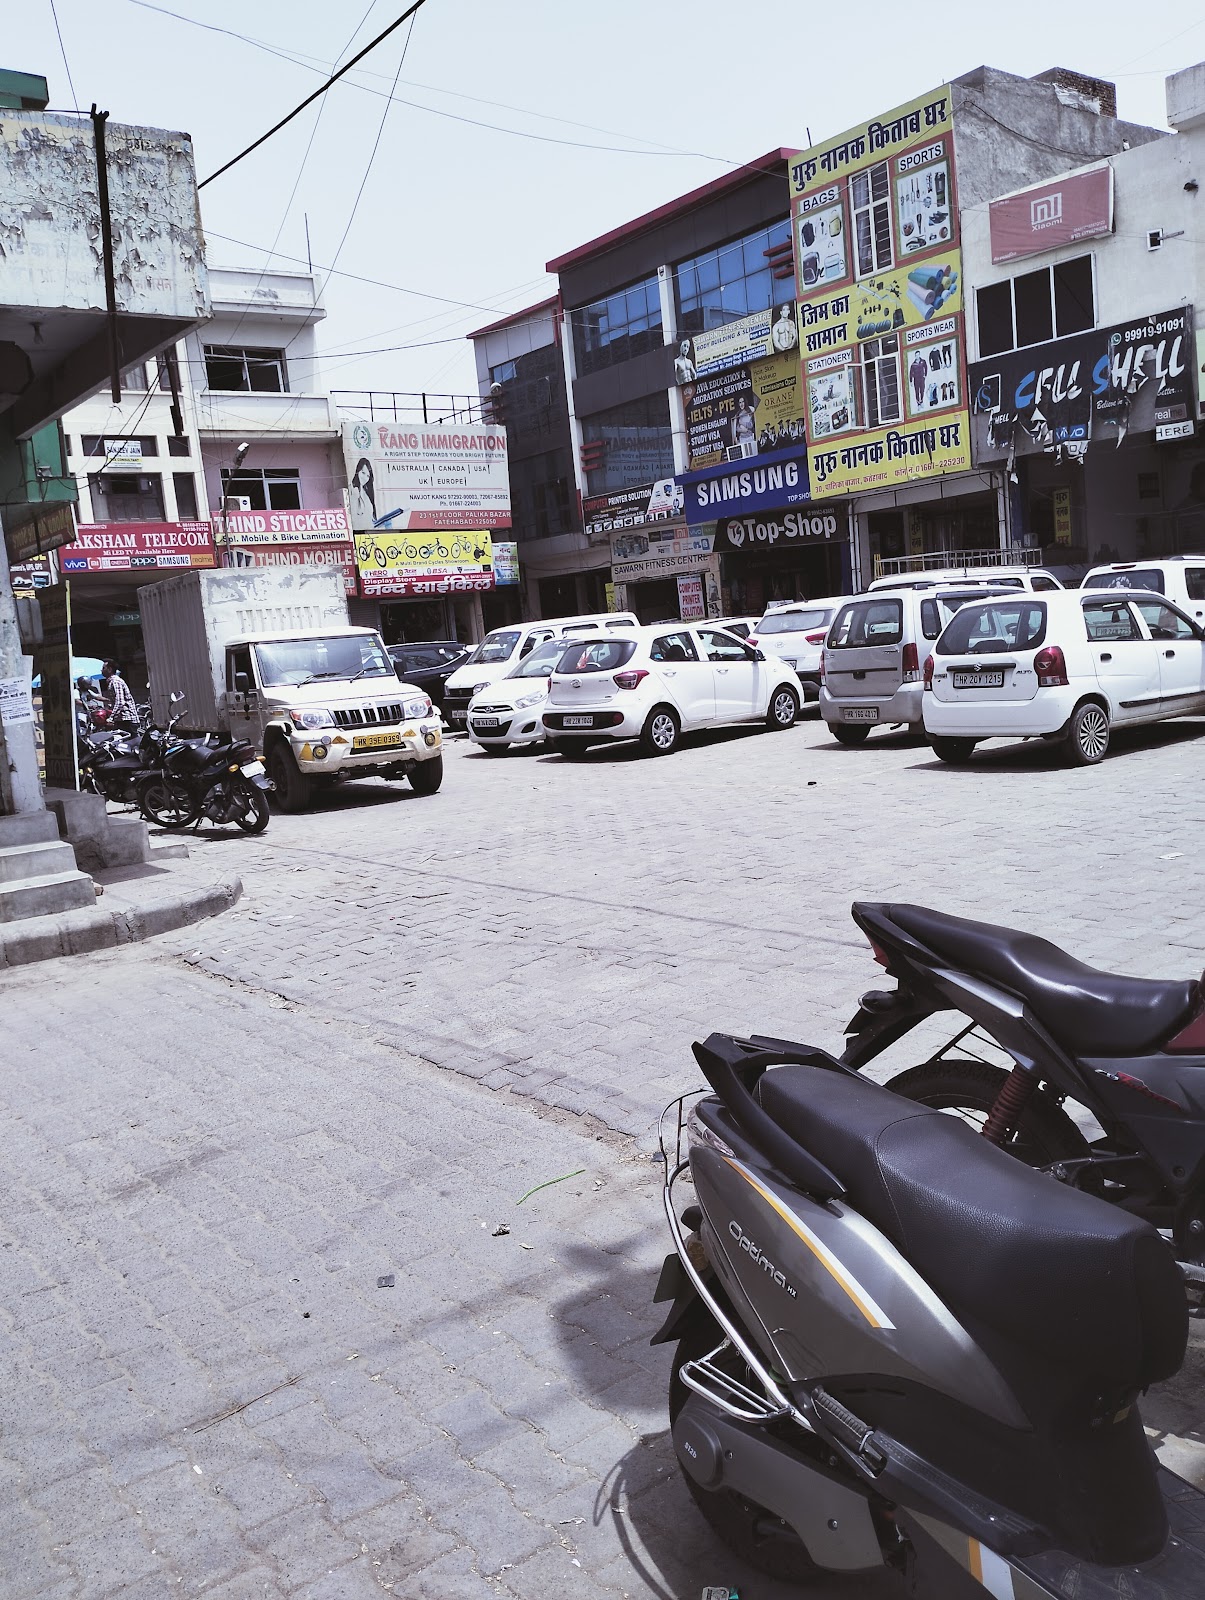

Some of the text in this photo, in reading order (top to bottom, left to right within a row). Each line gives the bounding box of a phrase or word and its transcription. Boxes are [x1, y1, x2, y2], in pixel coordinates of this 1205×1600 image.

[792, 98, 947, 192] गुरु नानक किताब घर
[900, 144, 941, 171] SPORTS
[802, 189, 835, 212] BAGS
[1031, 218, 1063, 231] Xiaomi
[801, 295, 850, 328] जिम का
[806, 323, 848, 352] सामान
[906, 322, 954, 342] SPORTS WEAR
[1124, 317, 1184, 342] 99919-91091
[808, 351, 852, 371] STATIONERY
[709, 372, 741, 390] EDUCATION
[741, 371, 746, 379] &
[724, 379, 752, 395] SERVICES
[764, 392, 793, 407] ORANE
[766, 401, 794, 411] INTERNATIONAL
[1096, 399, 1117, 410] Believe
[690, 398, 735, 423] IELTS PTE
[1155, 408, 1182, 420] realme
[690, 417, 728, 436] SPOKEN ENGLISH
[379, 433, 505, 451] KANG IMMIGRATION
[691, 430, 721, 446] STUDY VISA
[692, 444, 713, 457] TOURIST
[713, 441, 725, 451] VISA
[814, 423, 961, 482] गुरु नानक किताब घर
[697, 461, 798, 507] SAMSUNG
[608, 493, 628, 506] PRINTER
[628, 489, 652, 502] SOLUTION
[799, 492, 811, 500] SHO
[213, 513, 346, 533] THIND STICKERS
[743, 512, 837, 543] Top-Shop
[65, 533, 137, 551] AKSHAM
[142, 532, 209, 548] TELECOM
[241, 533, 269, 543] Mobile
[272, 533, 278, 541] &
[281, 532, 299, 541] Bike
[301, 530, 346, 540] Lamination
[65, 560, 86, 568] vivo
[131, 557, 156, 566] oppo
[159, 556, 189, 566] SAMSUNG
[257, 549, 352, 567] THIND MOBILE
[614, 554, 708, 575] SAWARN FITNESS CENTRE
[364, 578, 394, 586] Display
[679, 582, 702, 594] COMPUTER
[682, 594, 701, 605] PRINTER
[114, 613, 140, 621] opp
[682, 606, 704, 617] SOLUTION
[960, 676, 968, 685] HR
[985, 674, 1001, 684] 1215
[358, 738, 366, 746] HR
[728, 1219, 787, 1289] Optima
[786, 1285, 798, 1298] HX
